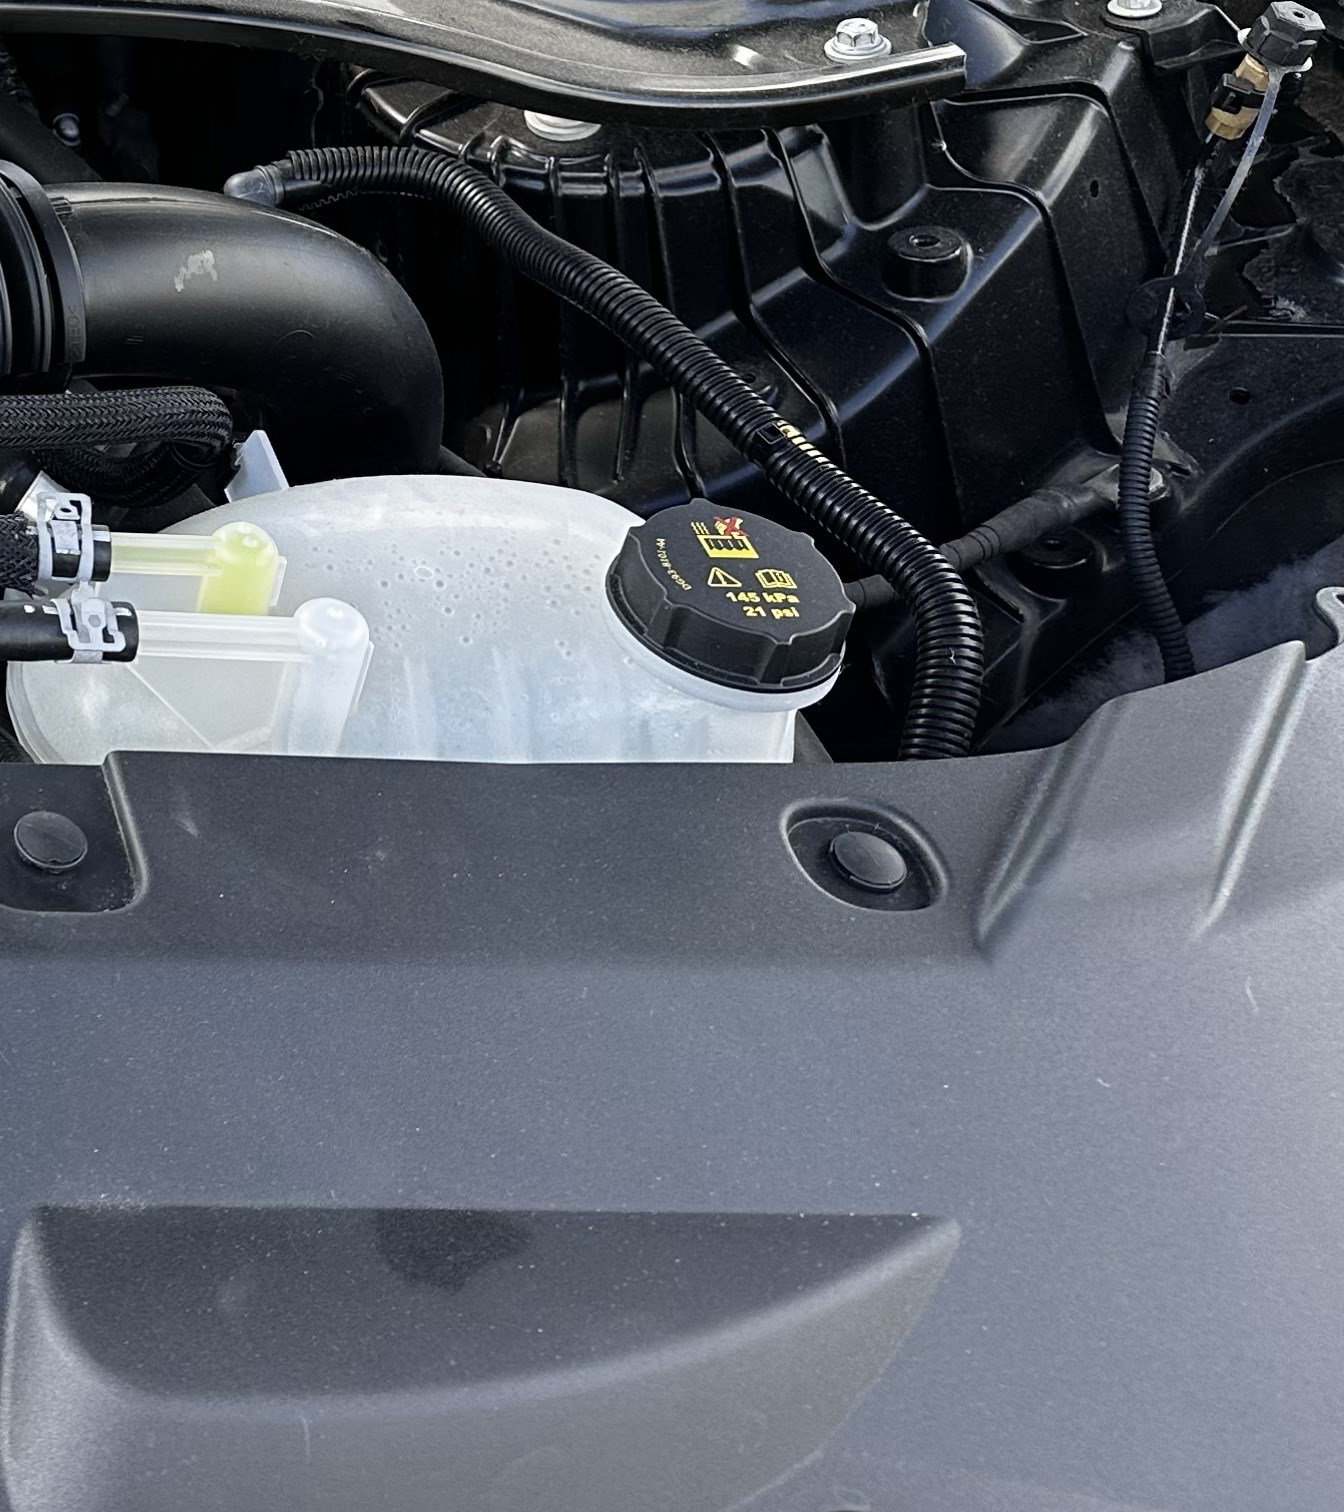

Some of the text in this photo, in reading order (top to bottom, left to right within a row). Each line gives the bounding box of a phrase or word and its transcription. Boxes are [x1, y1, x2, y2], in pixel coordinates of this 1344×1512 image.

[725, 591, 800, 603] 145 kPa
[742, 605, 800, 619] 21 psi
